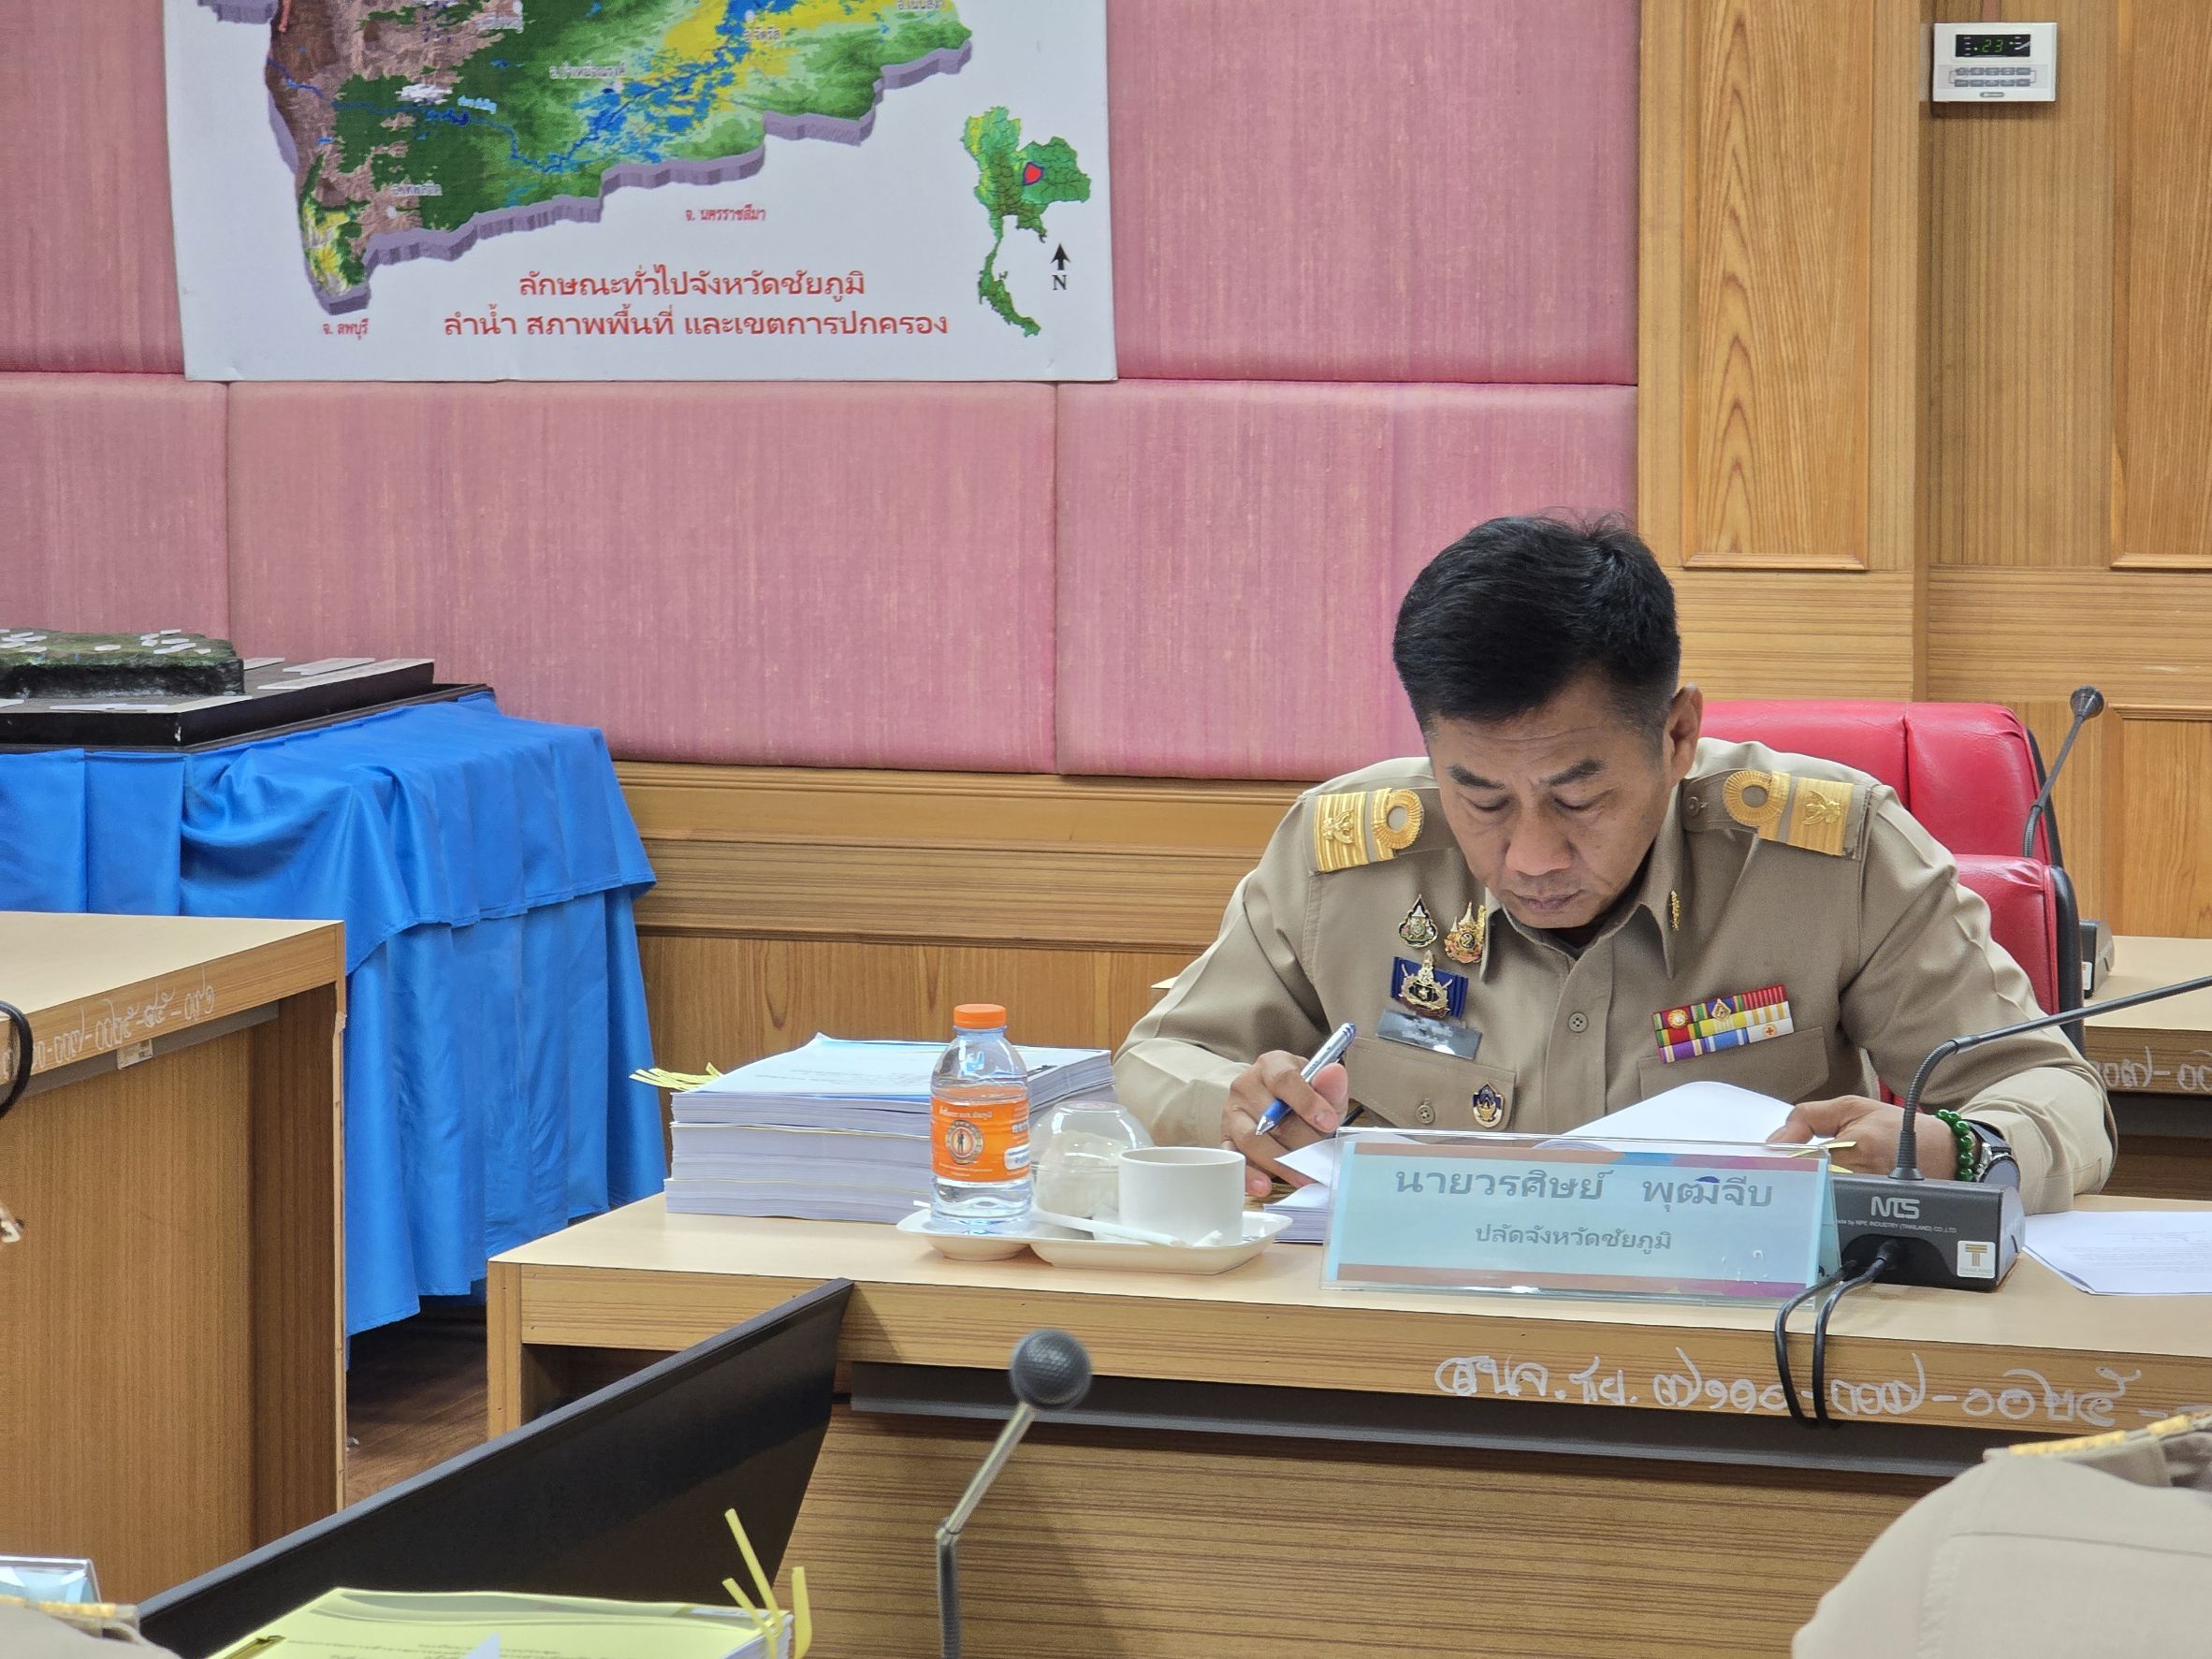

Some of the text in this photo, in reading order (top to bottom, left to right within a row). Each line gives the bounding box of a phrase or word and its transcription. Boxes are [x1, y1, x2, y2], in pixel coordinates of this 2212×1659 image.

[1982, 38, 2003, 52] 23
[519, 264, 866, 302] ลักษณะทั่วไปจังหวัดชัยภูมิ
[1053, 275, 1068, 290] N
[444, 303, 949, 336] ลำน้ำ สภาพพื้นที่ และเขตการปกครอง
[1395, 1169, 1614, 1201] นายวรศิษย์
[1476, 1223, 1671, 1255] ปลัดจังหวัดชัยภูมิ
[1869, 1220, 1899, 1229] INDUSTRY
